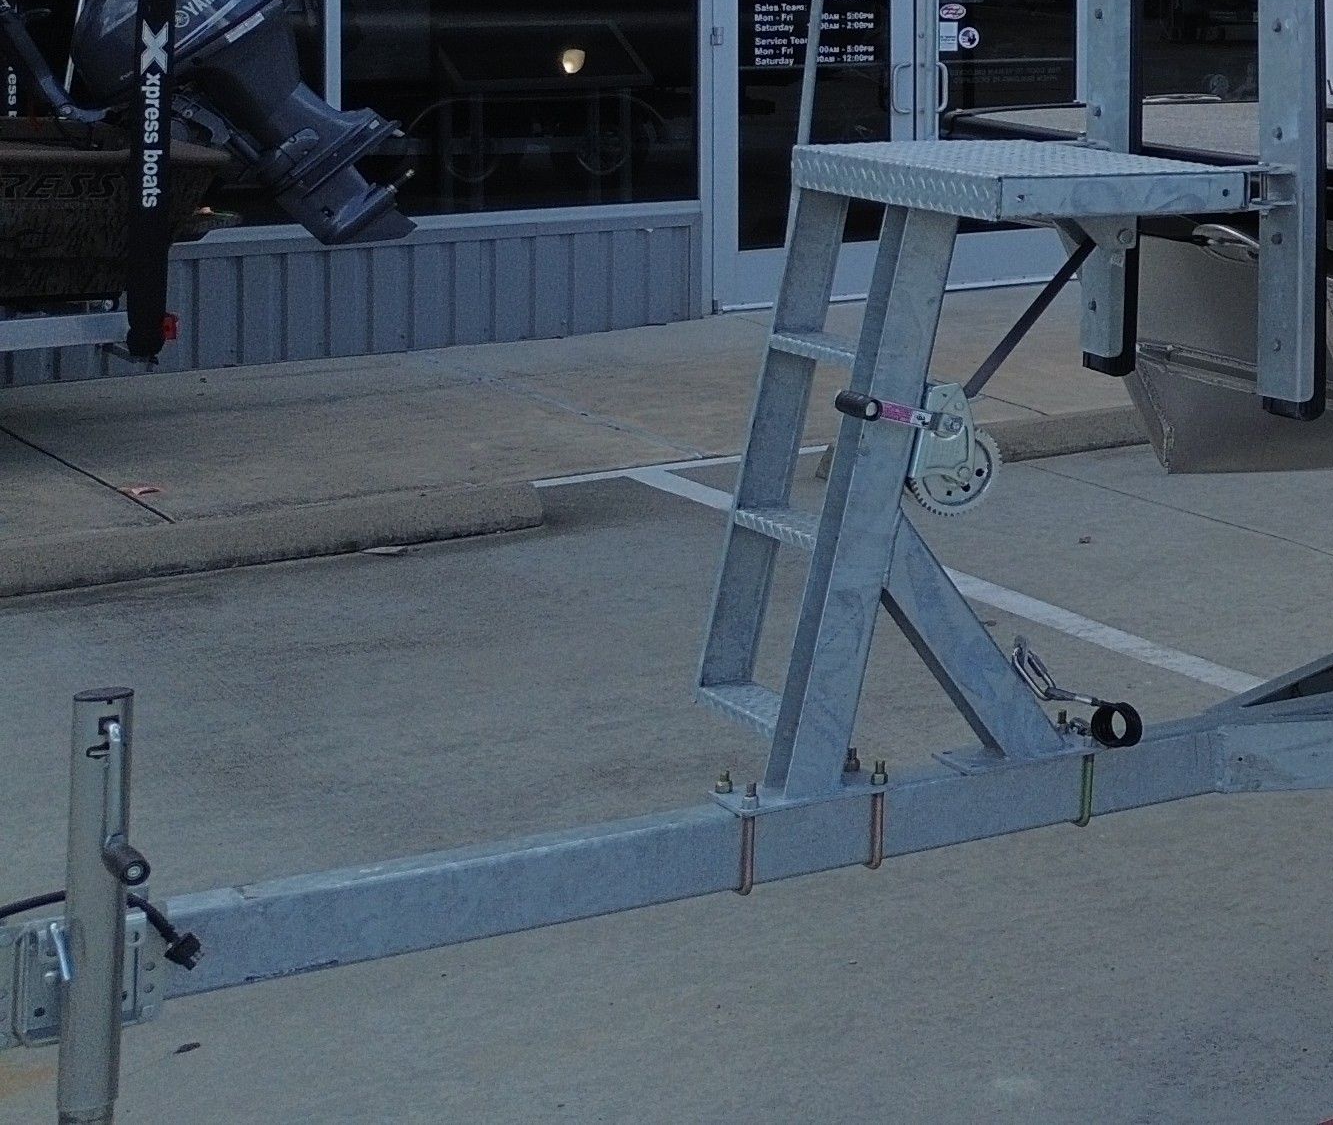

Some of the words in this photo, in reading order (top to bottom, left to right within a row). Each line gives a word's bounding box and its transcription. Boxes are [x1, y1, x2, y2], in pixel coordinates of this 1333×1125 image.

[754, 13, 774, 22] Mon
[781, 13, 794, 22] Fri
[754, 23, 794, 33] Saturday
[755, 37, 788, 46] Service
[754, 47, 774, 55] Mon
[781, 46, 794, 55] Fri
[755, 57, 794, 66] Saturday
[142, 149, 163, 209] boats
